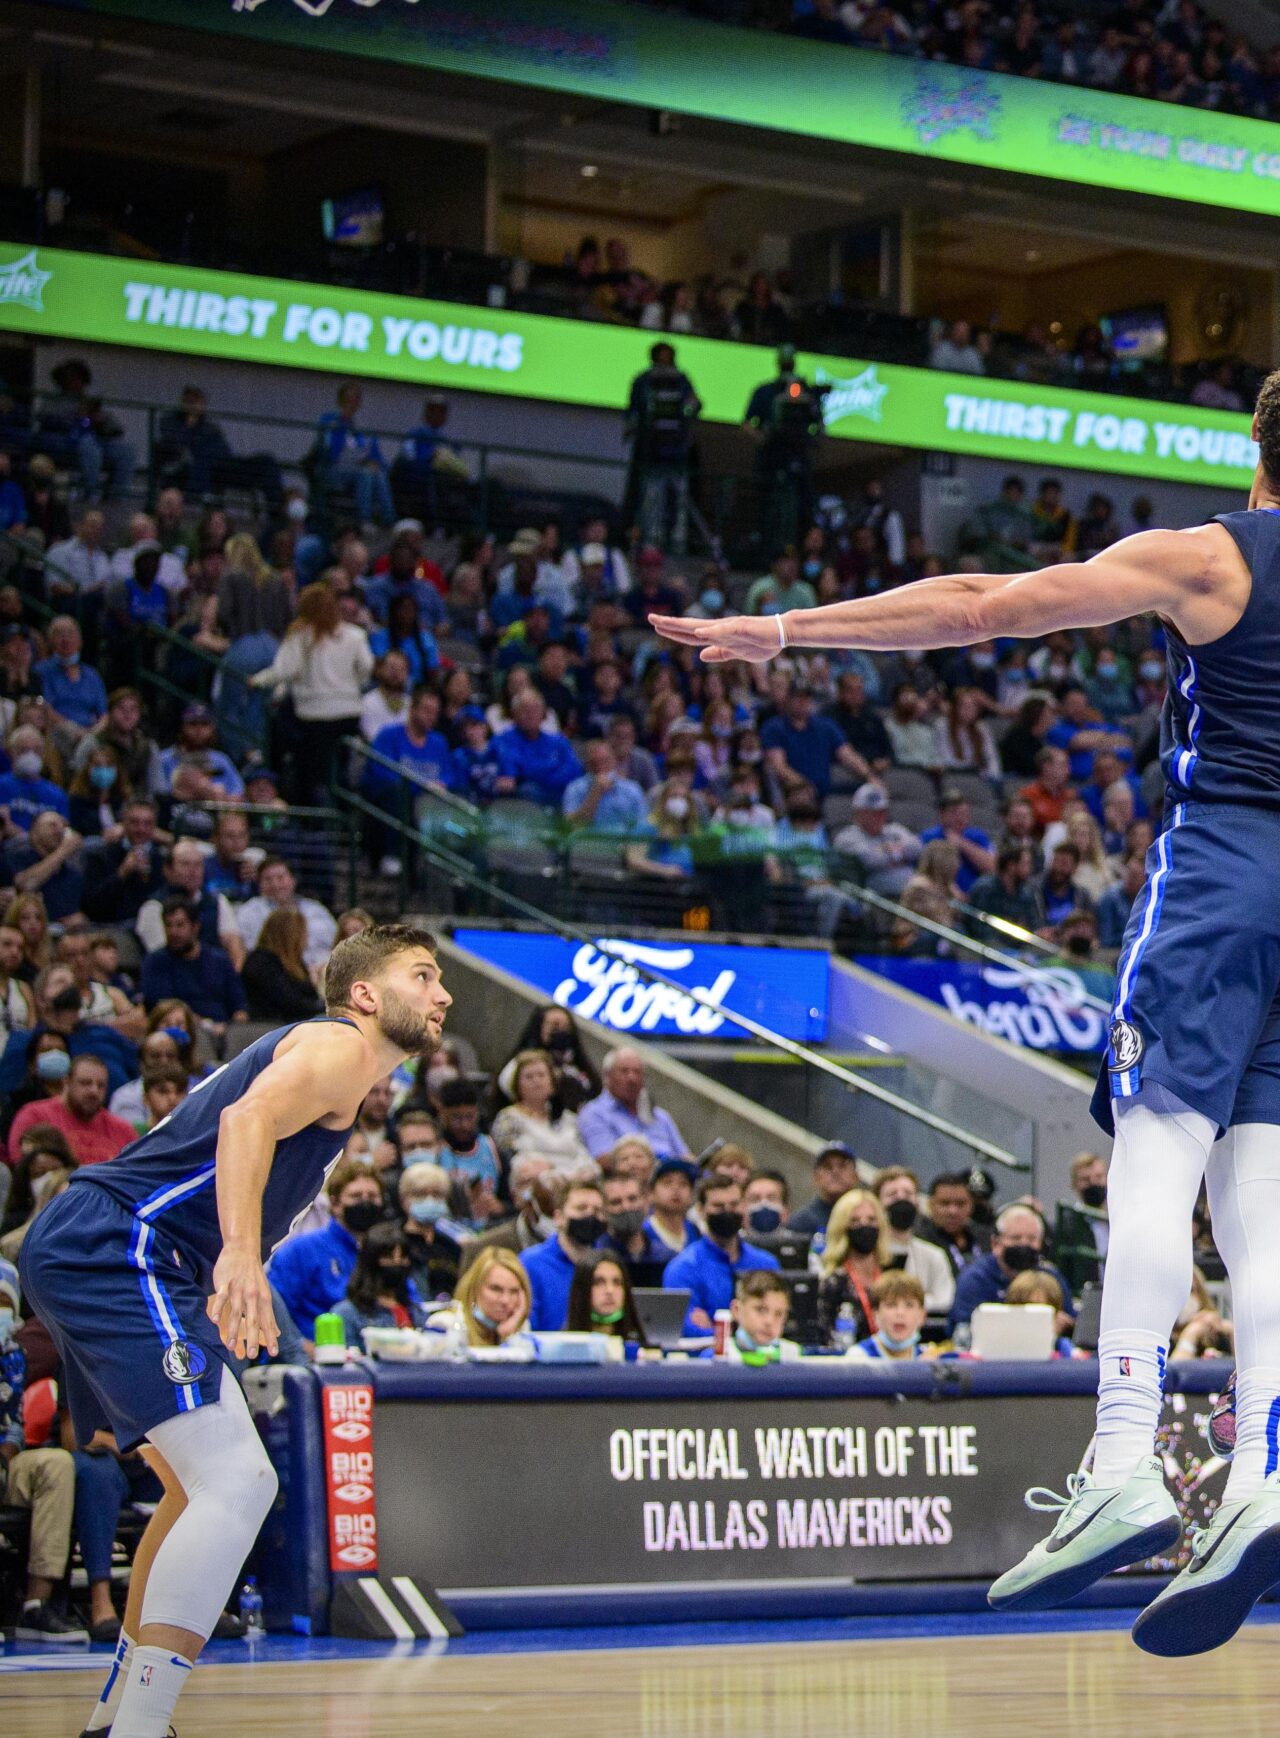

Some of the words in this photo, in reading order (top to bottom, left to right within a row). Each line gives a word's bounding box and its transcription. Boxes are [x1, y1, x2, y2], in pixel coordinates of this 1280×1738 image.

[124, 282, 277, 338] THIRST
[283, 303, 372, 352] FOR
[381, 315, 525, 372] YOURS
[944, 394, 1070, 444] THIRST
[1073, 411, 1148, 455] FOR
[553, 938, 736, 1035] Ford
[328, 1389, 371, 1411] BIO
[331, 1451, 373, 1473] BIO
[610, 1428, 749, 1481] OFFICIAL
[755, 1426, 868, 1479] WATCH
[874, 1426, 914, 1478] OF
[918, 1425, 979, 1476] THE
[334, 1513, 376, 1535] BIO
[643, 1500, 770, 1551] DALLAS
[776, 1496, 953, 1548] MAVERICKS
